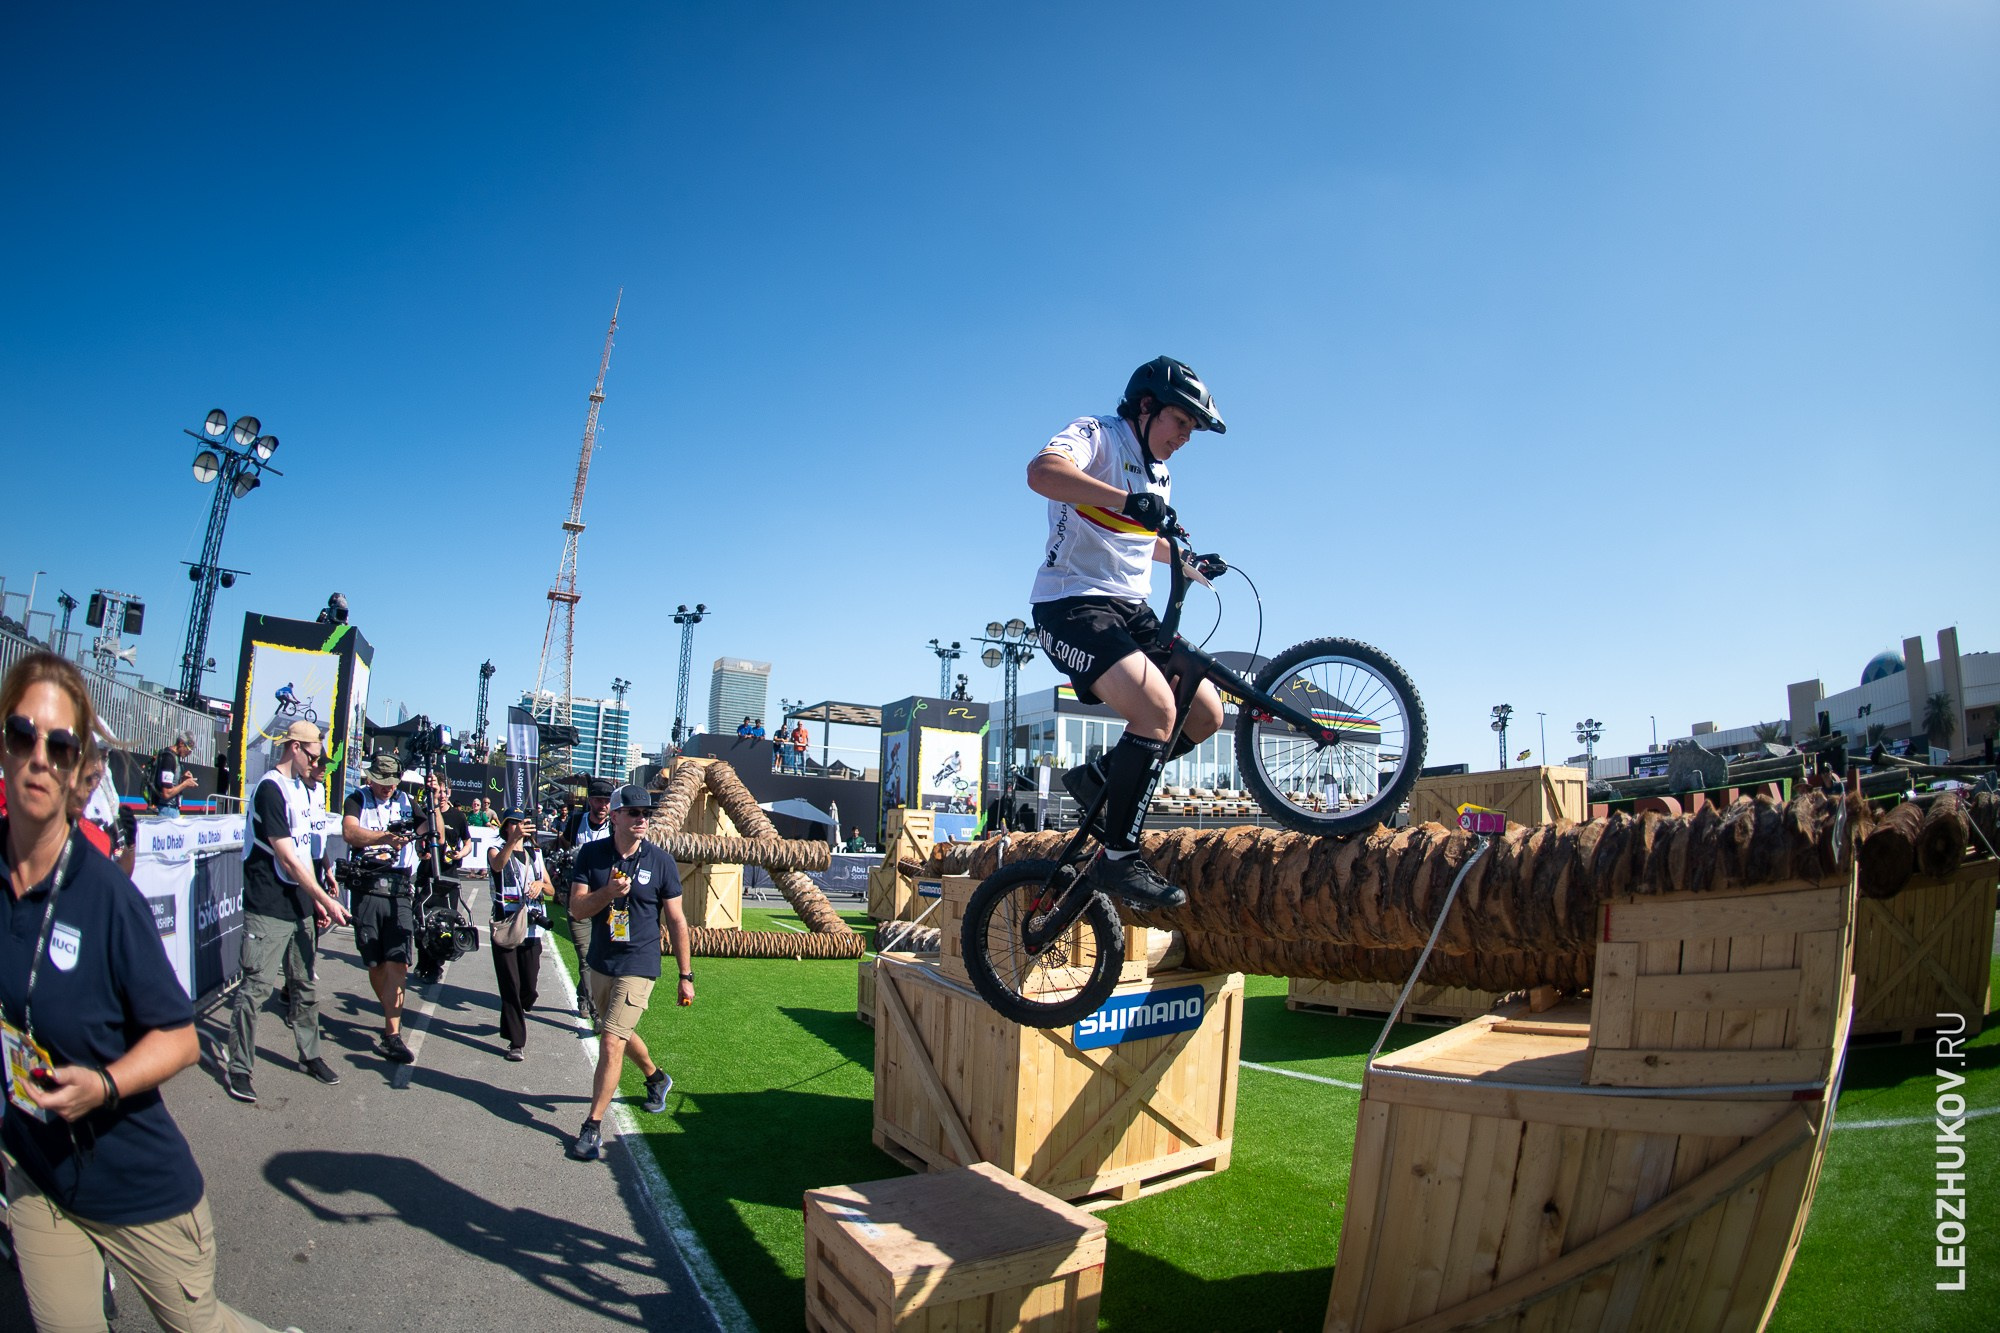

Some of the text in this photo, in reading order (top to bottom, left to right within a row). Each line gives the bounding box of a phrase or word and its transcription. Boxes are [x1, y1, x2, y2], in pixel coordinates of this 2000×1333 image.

[467, 780, 483, 788] dhabi
[1126, 777, 1157, 843] hebo
[152, 834, 185, 851] Abu Dhabi
[197, 829, 221, 845] Abu Dhabi
[219, 892, 235, 918] abu
[1080, 997, 1201, 1036] SHIMANO
